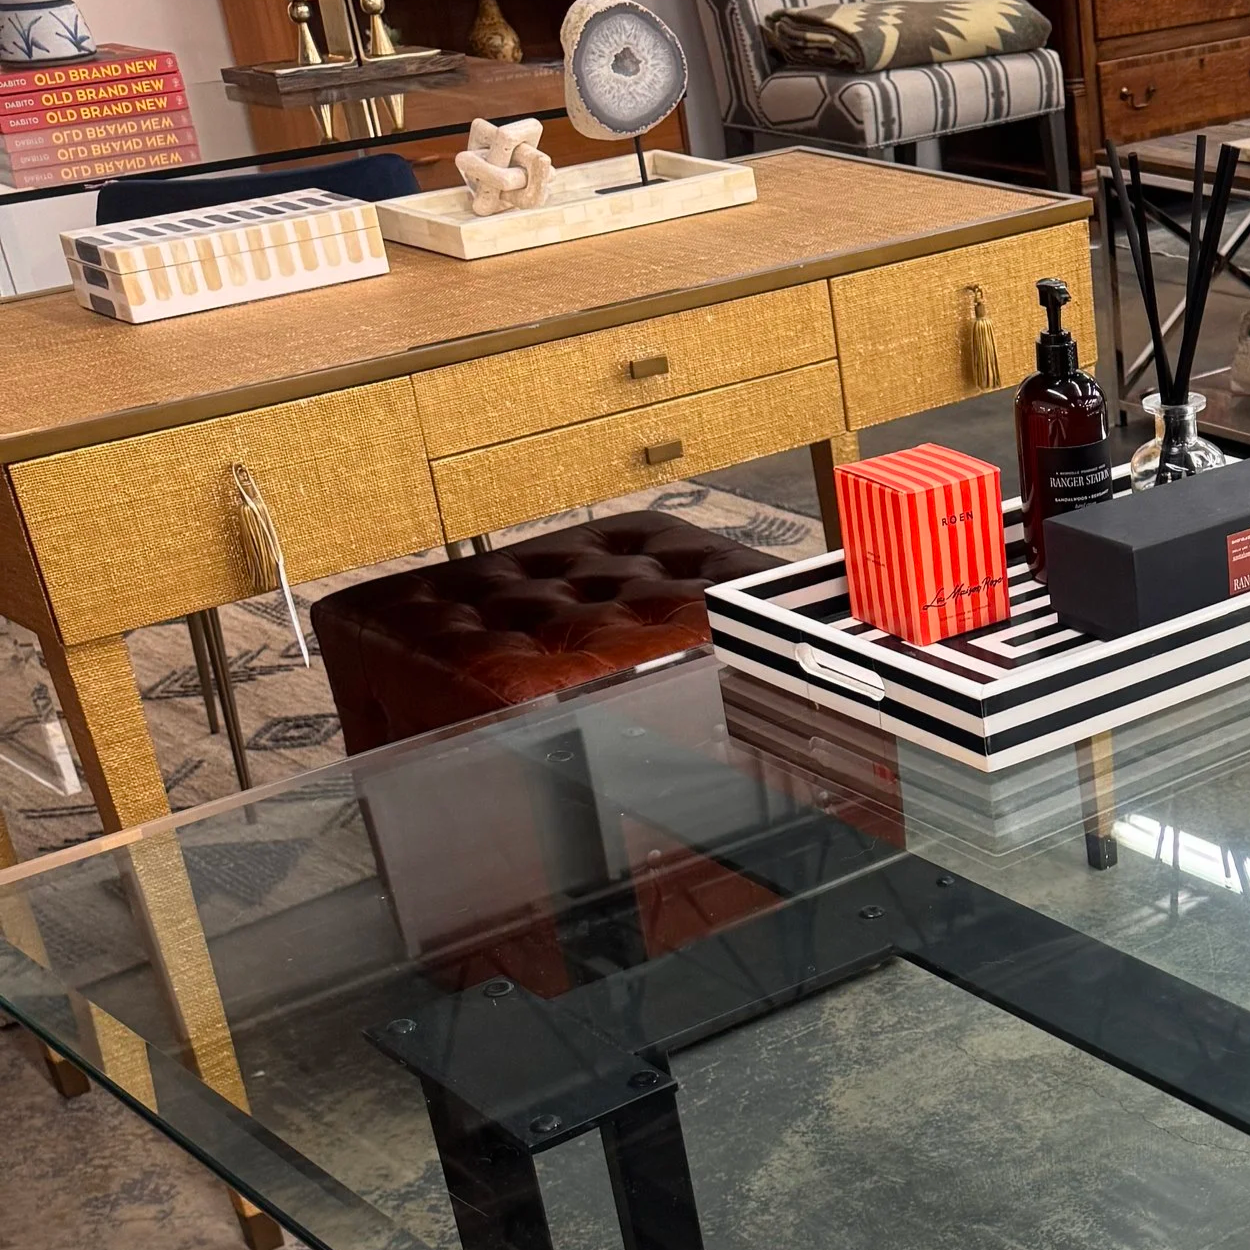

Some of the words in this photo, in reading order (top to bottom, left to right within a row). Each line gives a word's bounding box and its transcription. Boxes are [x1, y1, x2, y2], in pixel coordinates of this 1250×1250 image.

[34, 72, 66, 86] OLD
[68, 64, 122, 82] BRAND
[124, 59, 158, 75] NEW
[4, 99, 35, 110] DABITO
[41, 91, 73, 106] OLD
[76, 84, 129, 102] BRAND
[131, 78, 164, 95] NEW
[9, 117, 39, 128] DABITO
[46, 109, 77, 124] OLD
[80, 102, 133, 119] BRAND
[135, 96, 168, 112] NEW
[1049, 476, 1085, 488] RANGER
[942, 511, 974, 527] ROEN
[946, 583, 982, 605] Maison
